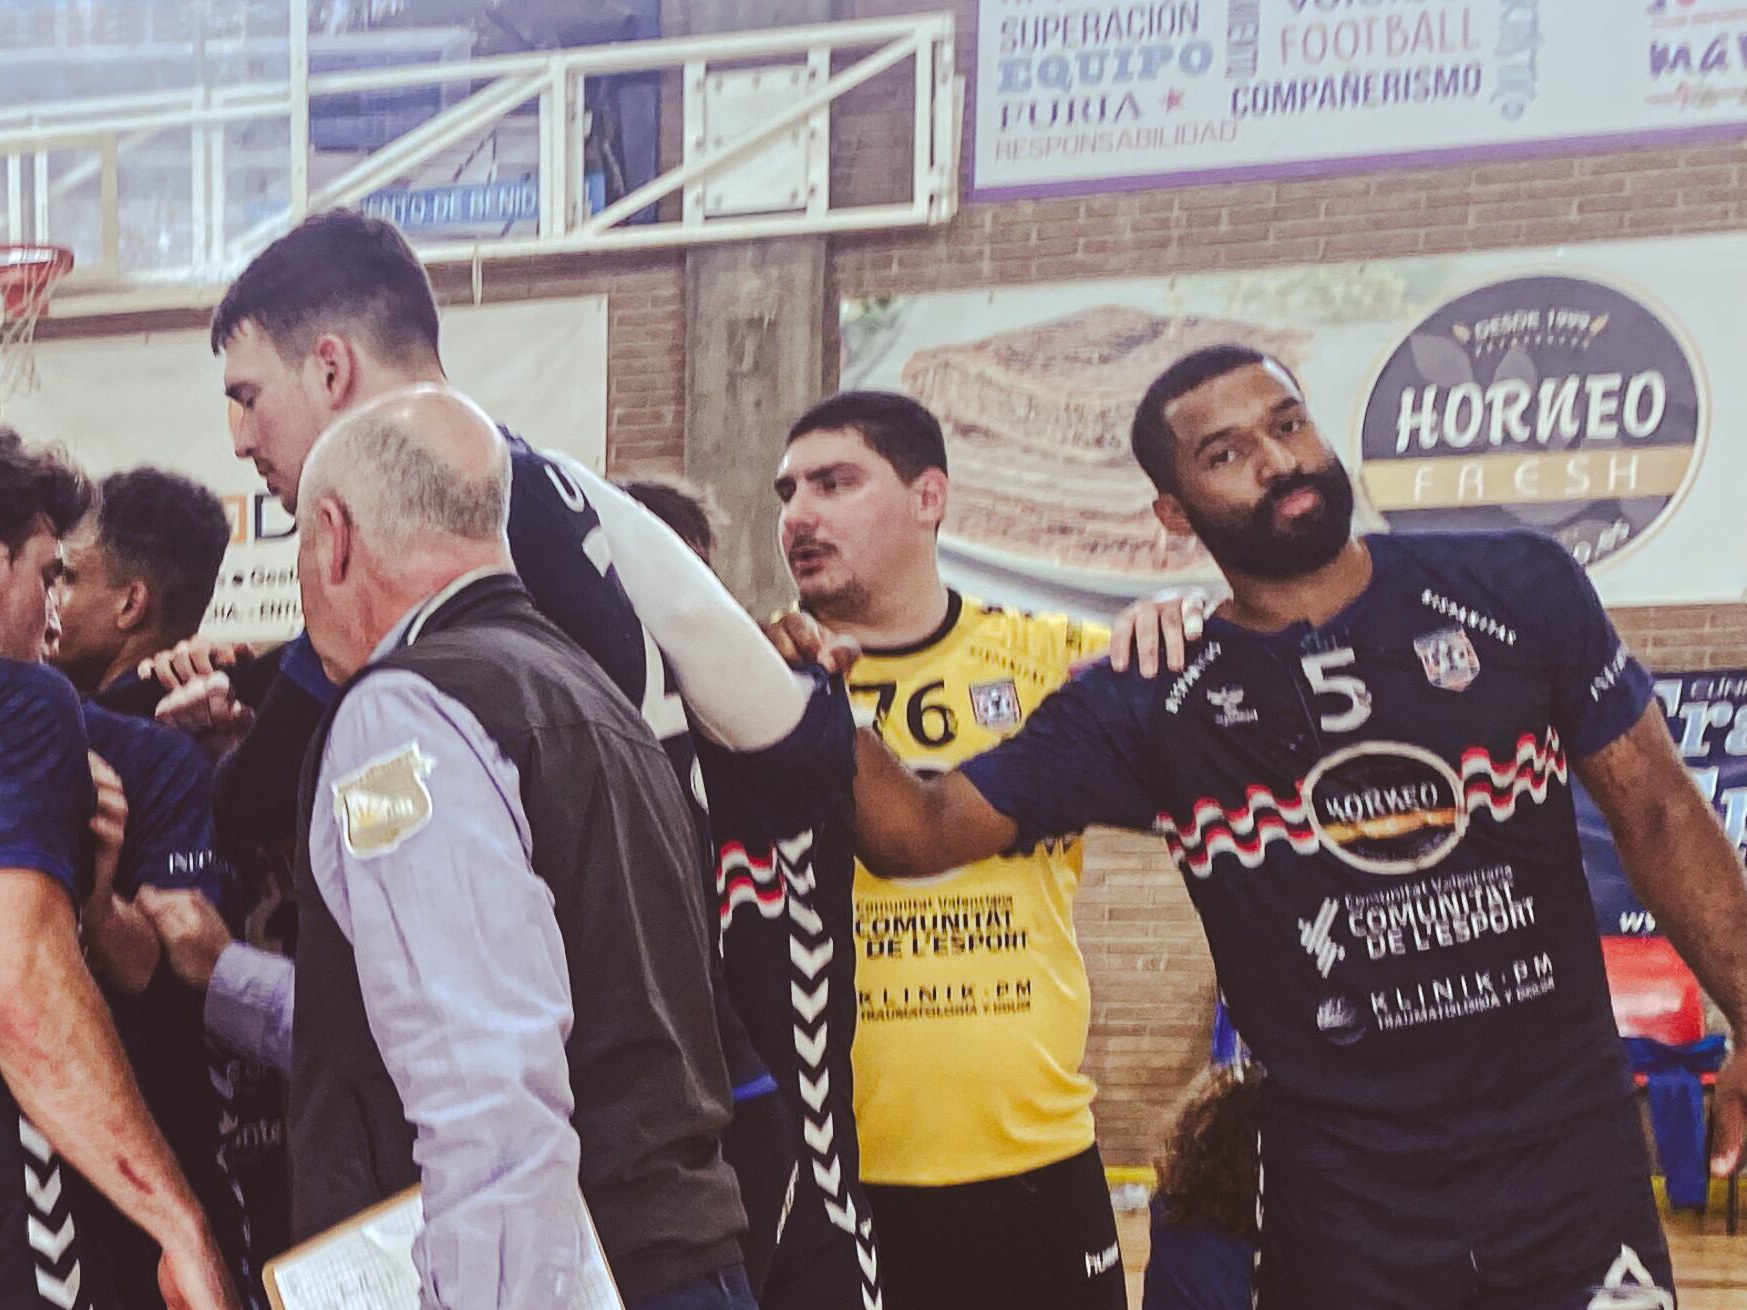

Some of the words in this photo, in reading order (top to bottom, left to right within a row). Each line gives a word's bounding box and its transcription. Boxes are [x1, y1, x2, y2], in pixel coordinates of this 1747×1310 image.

[1280, 6, 1482, 66] FOOTBALL
[998, 39, 1213, 95] EQUIPO
[1000, 91, 1141, 131] FURIA
[996, 118, 1238, 162] RESPONSABILIDAD
[1396, 368, 1667, 455] HORNEO
[1302, 648, 1372, 733] 5
[855, 910, 1012, 938] COMUNITAT
[866, 939, 903, 960] DE
